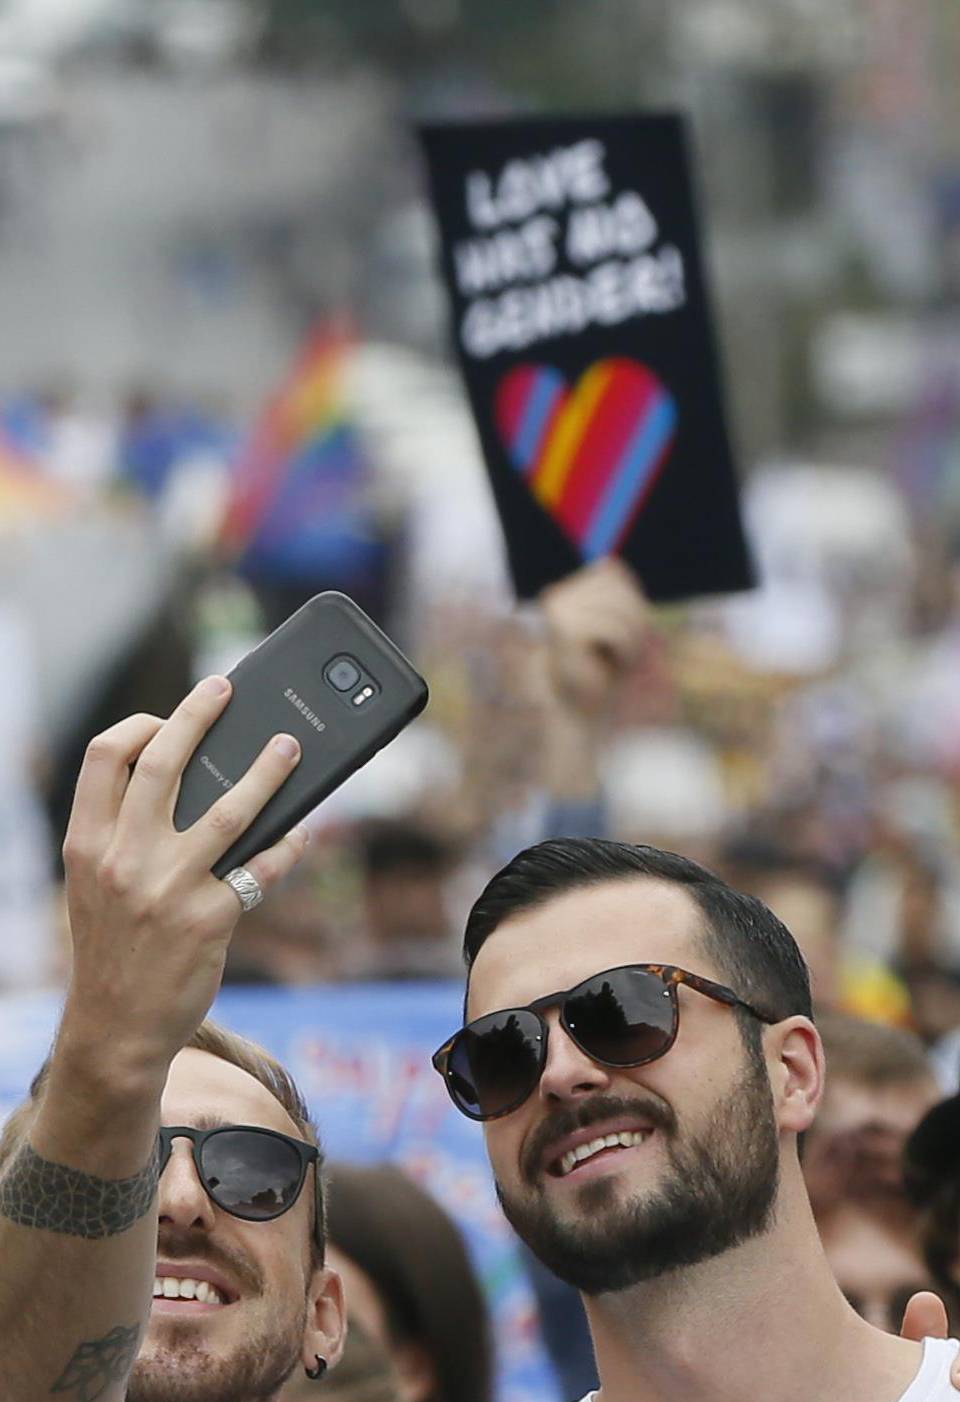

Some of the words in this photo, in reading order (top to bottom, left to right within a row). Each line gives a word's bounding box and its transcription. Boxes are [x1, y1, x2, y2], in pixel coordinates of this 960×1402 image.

[466, 139, 608, 228] LOVE
[566, 191, 656, 265] NO
[462, 244, 685, 358] GENDER!
[283, 688, 326, 732] SAMSUNG
